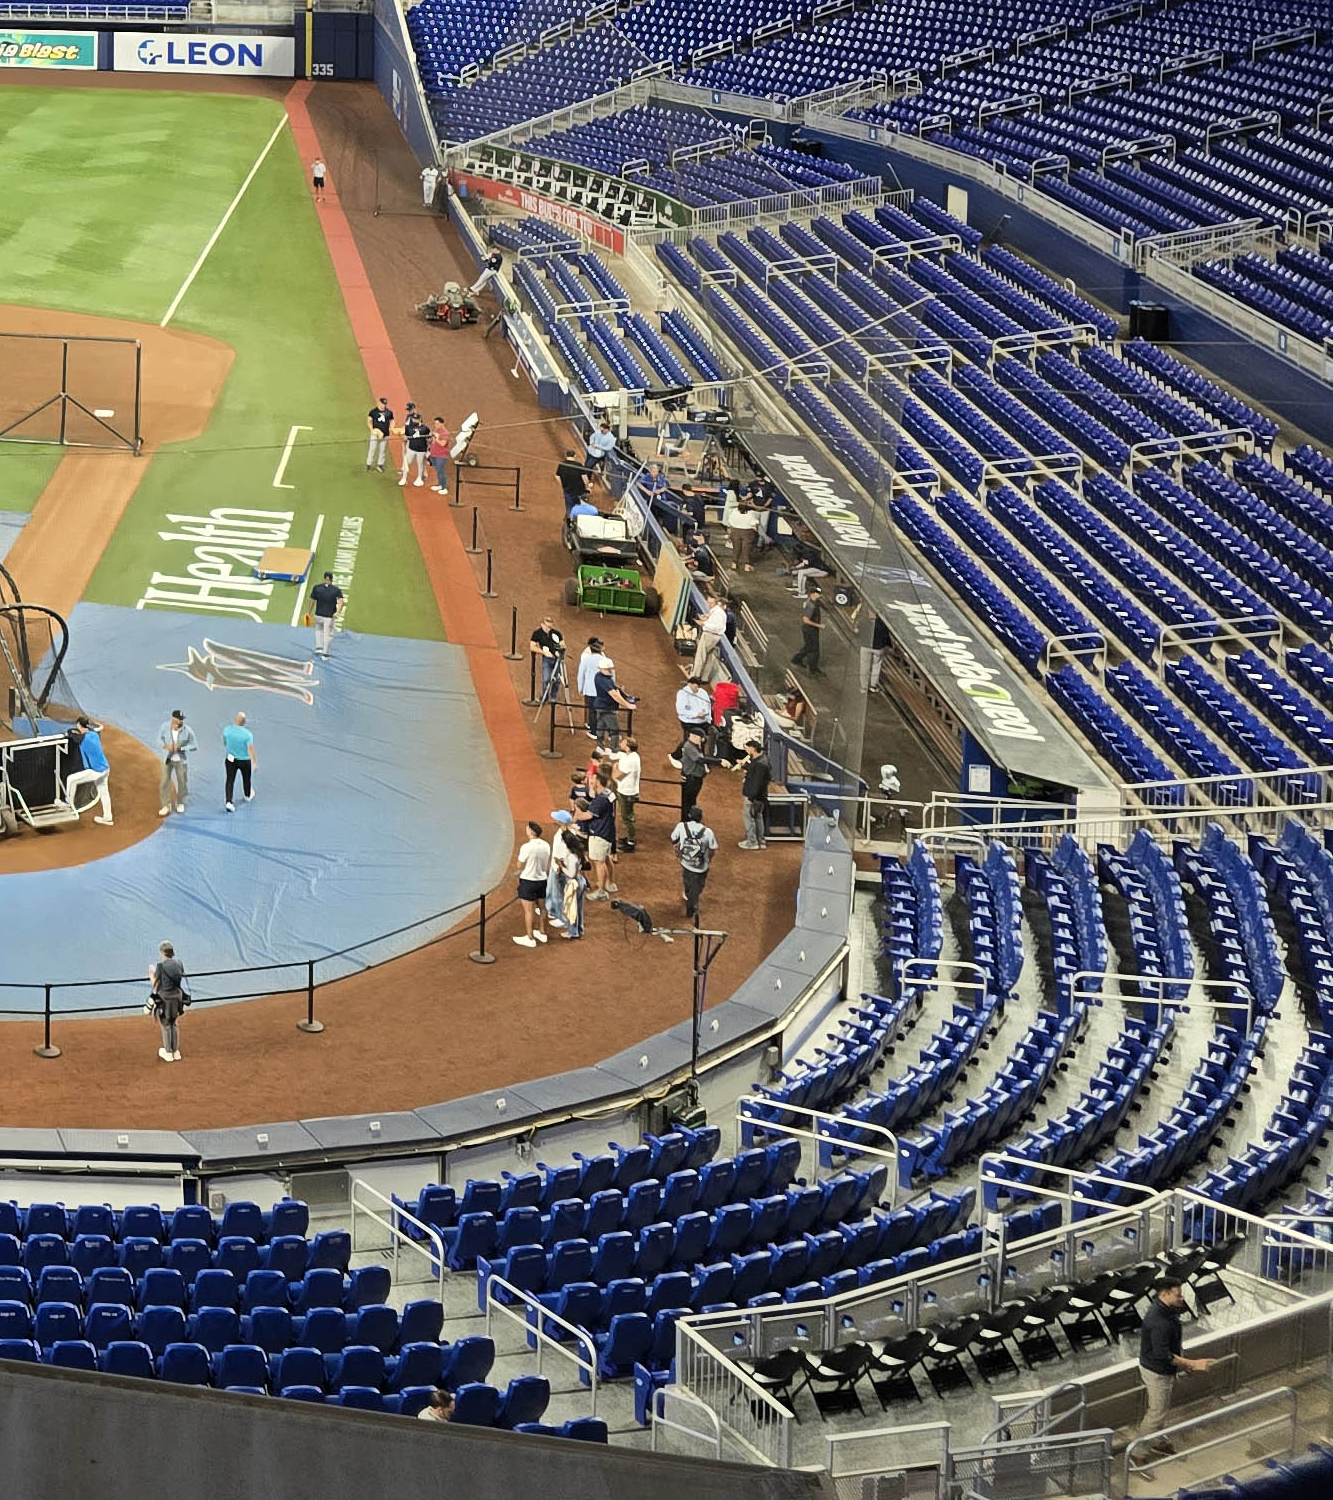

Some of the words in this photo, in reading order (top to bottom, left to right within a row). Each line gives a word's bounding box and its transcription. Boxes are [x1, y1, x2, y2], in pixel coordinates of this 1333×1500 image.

[19, 42, 80, 60] Blast
[168, 41, 263, 67] LEON
[312, 63, 334, 76] 335
[520, 191, 538, 213] THIS
[562, 207, 578, 228] FOR
[579, 214, 594, 236] YOU
[337, 515, 364, 549] MARLINS
